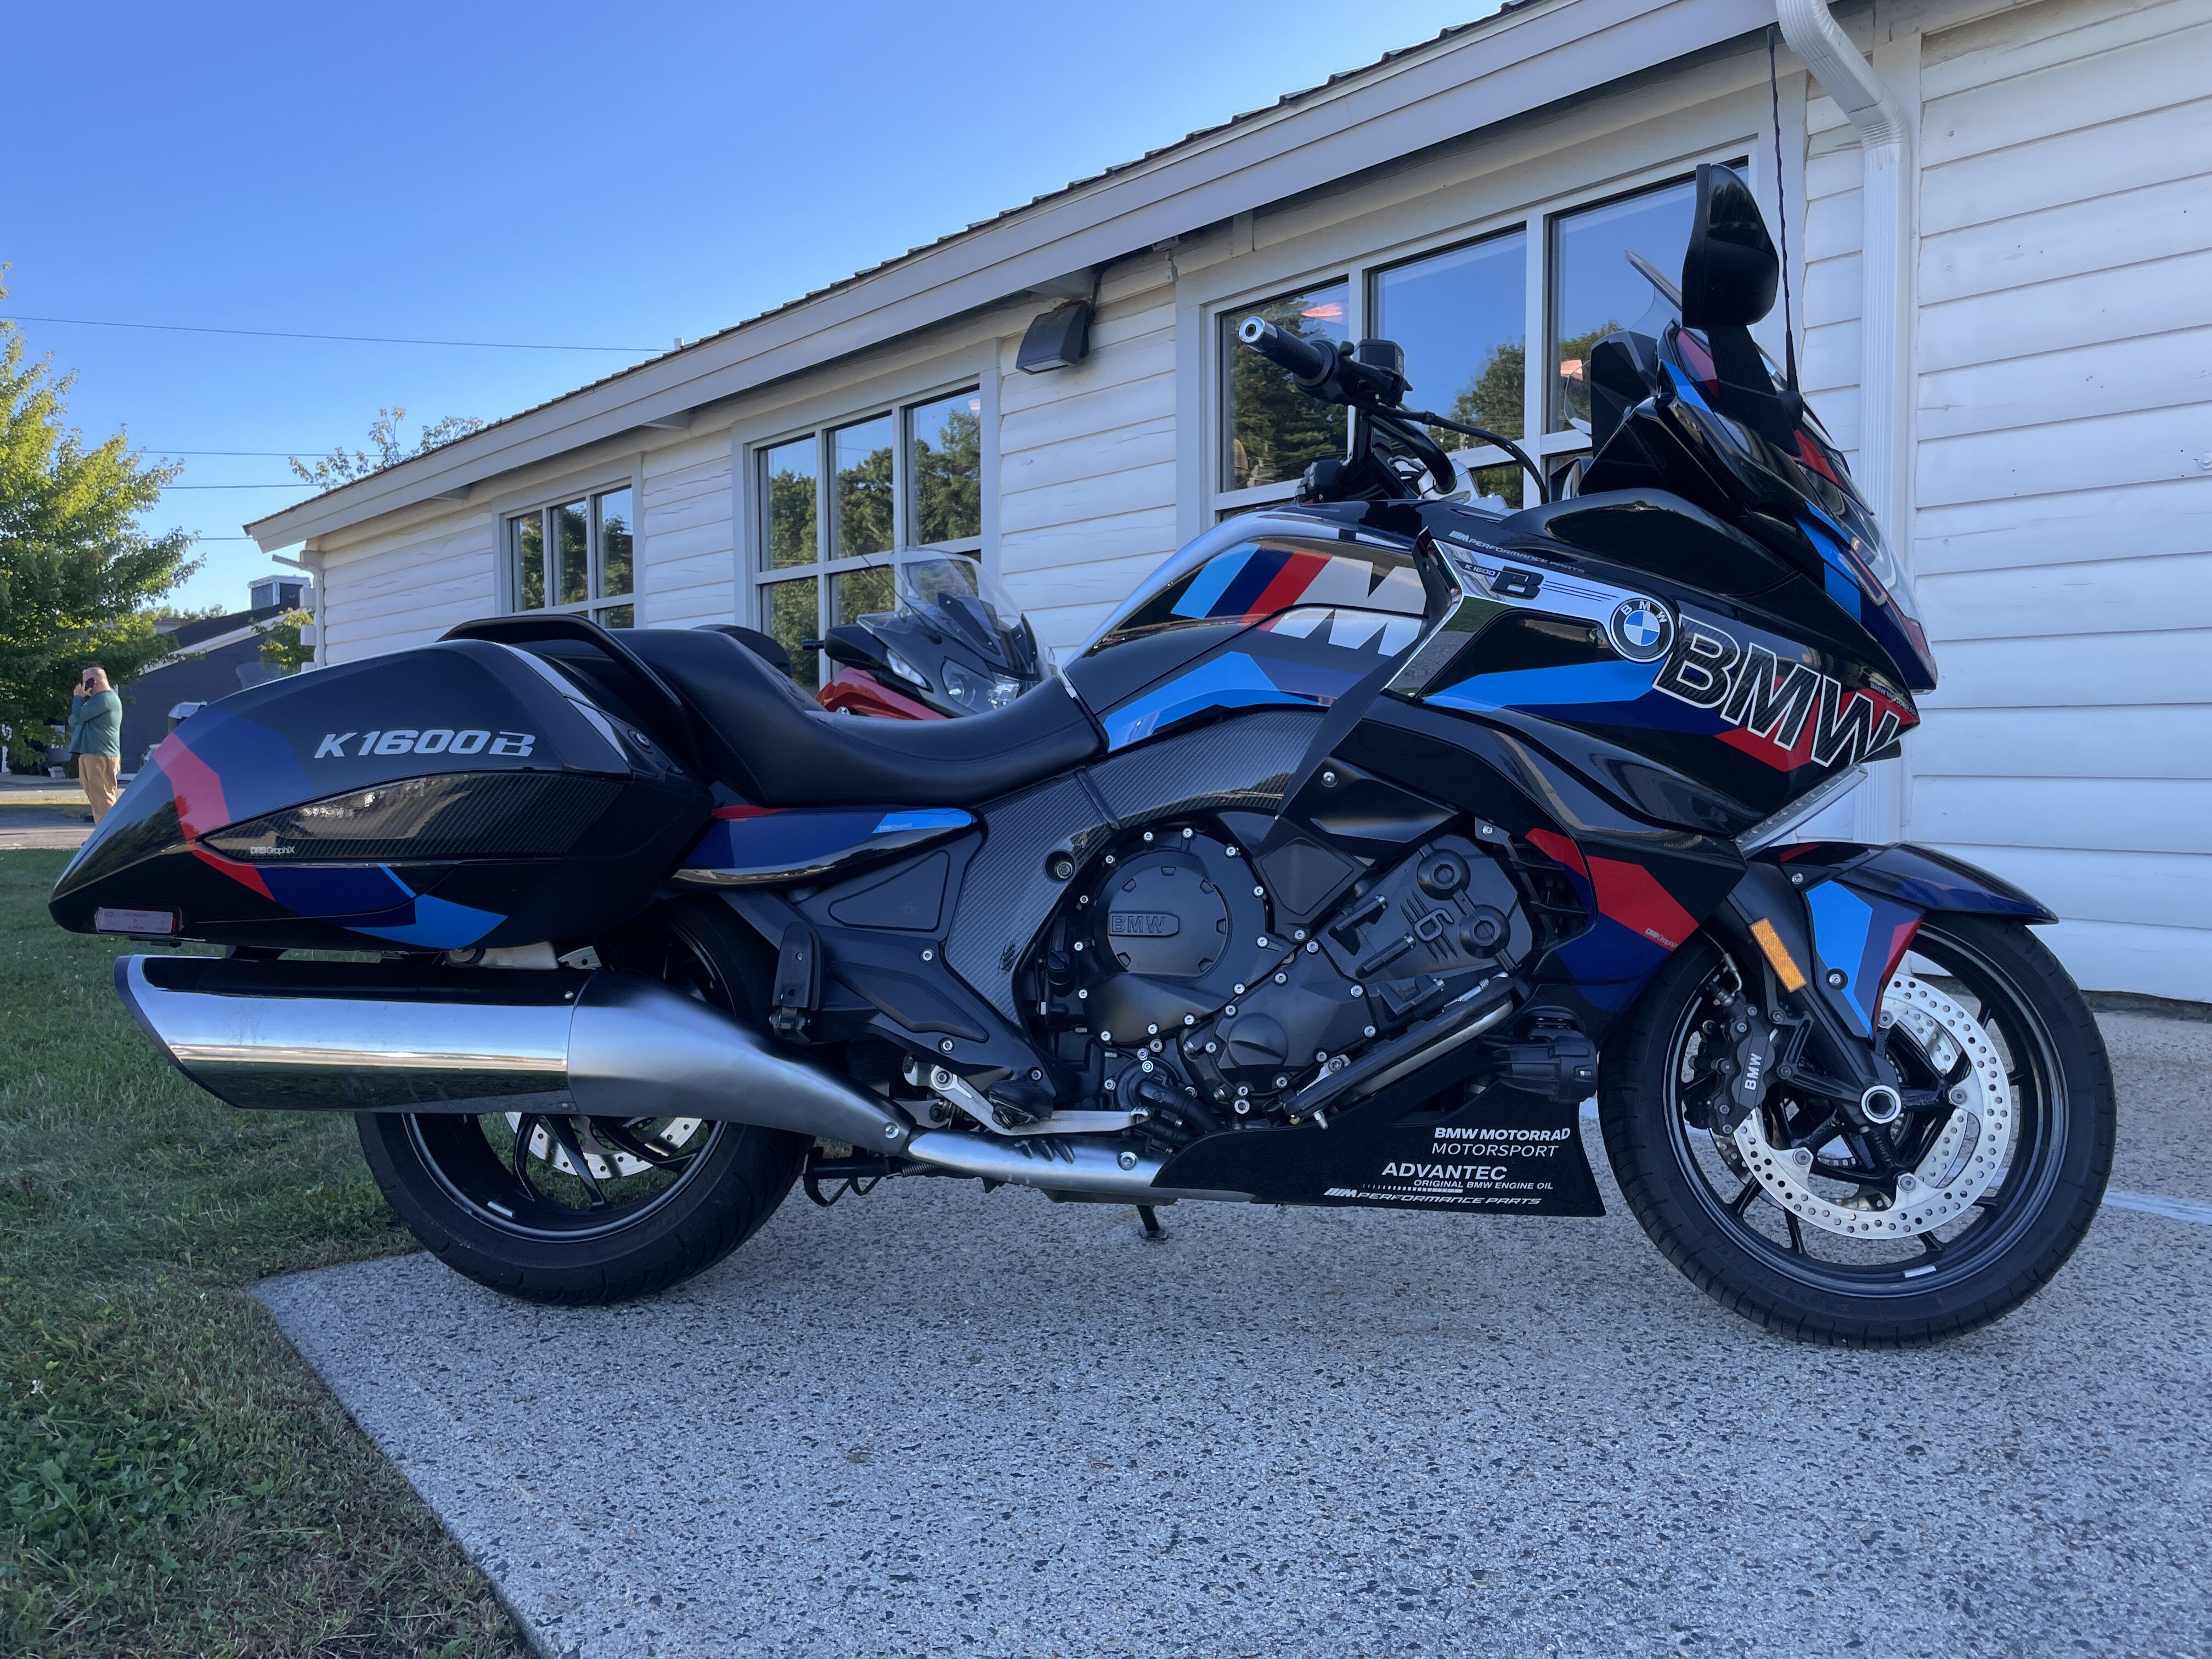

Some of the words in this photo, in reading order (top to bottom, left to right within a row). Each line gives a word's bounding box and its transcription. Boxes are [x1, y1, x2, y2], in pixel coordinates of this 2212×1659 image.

[1549, 561, 1585, 573] PARTS
[1620, 600, 1668, 623] BMW
[1652, 613, 1901, 768] BMW
[1870, 681, 1886, 696] BMW
[1111, 915, 1166, 933] BMW
[1745, 1053, 1762, 1091] BMW
[1434, 1127, 1479, 1139] BMW
[1479, 1127, 1571, 1141] MOTORRAD
[1431, 1142, 1559, 1157] MOTORSPORT
[1381, 1161, 1508, 1181] ADVANTEC
[1413, 1179, 1464, 1188] ORIGINAL
[1466, 1181, 1493, 1189] BMW
[1494, 1182, 1534, 1190] ENGINE
[1356, 1192, 1486, 1204] PERFORMANCE
